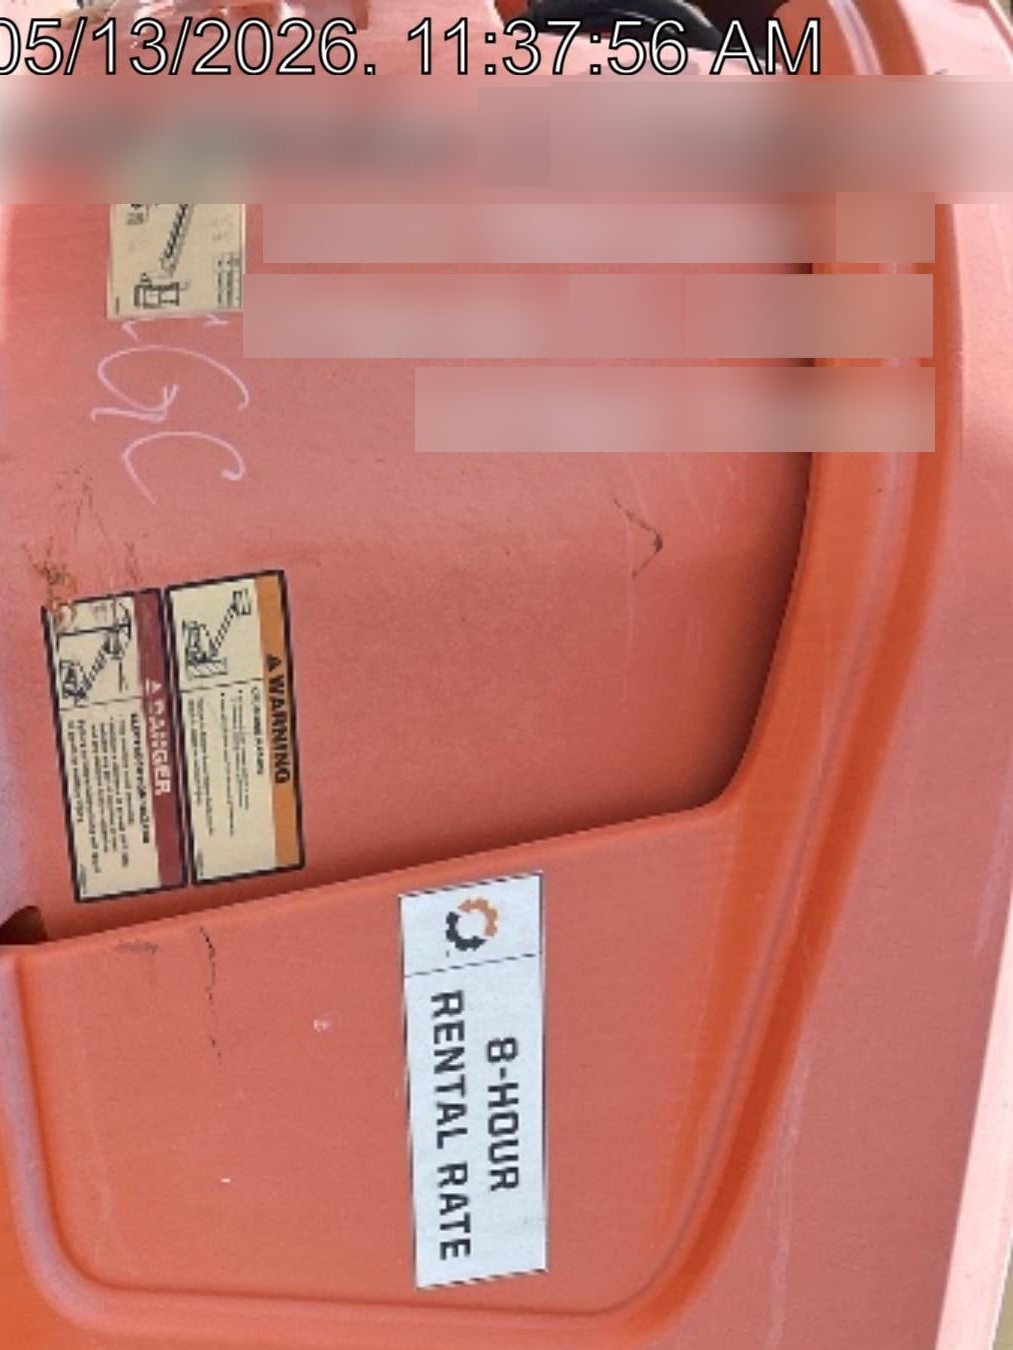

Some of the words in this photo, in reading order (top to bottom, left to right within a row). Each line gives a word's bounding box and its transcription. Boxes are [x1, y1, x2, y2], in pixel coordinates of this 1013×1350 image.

[148, 699, 171, 796] DANGER
[267, 674, 291, 785] WARNING
[431, 990, 468, 1150] RENTAL
[487, 1037, 520, 1192] 8-HOUR
[438, 1162, 471, 1261] RATE
